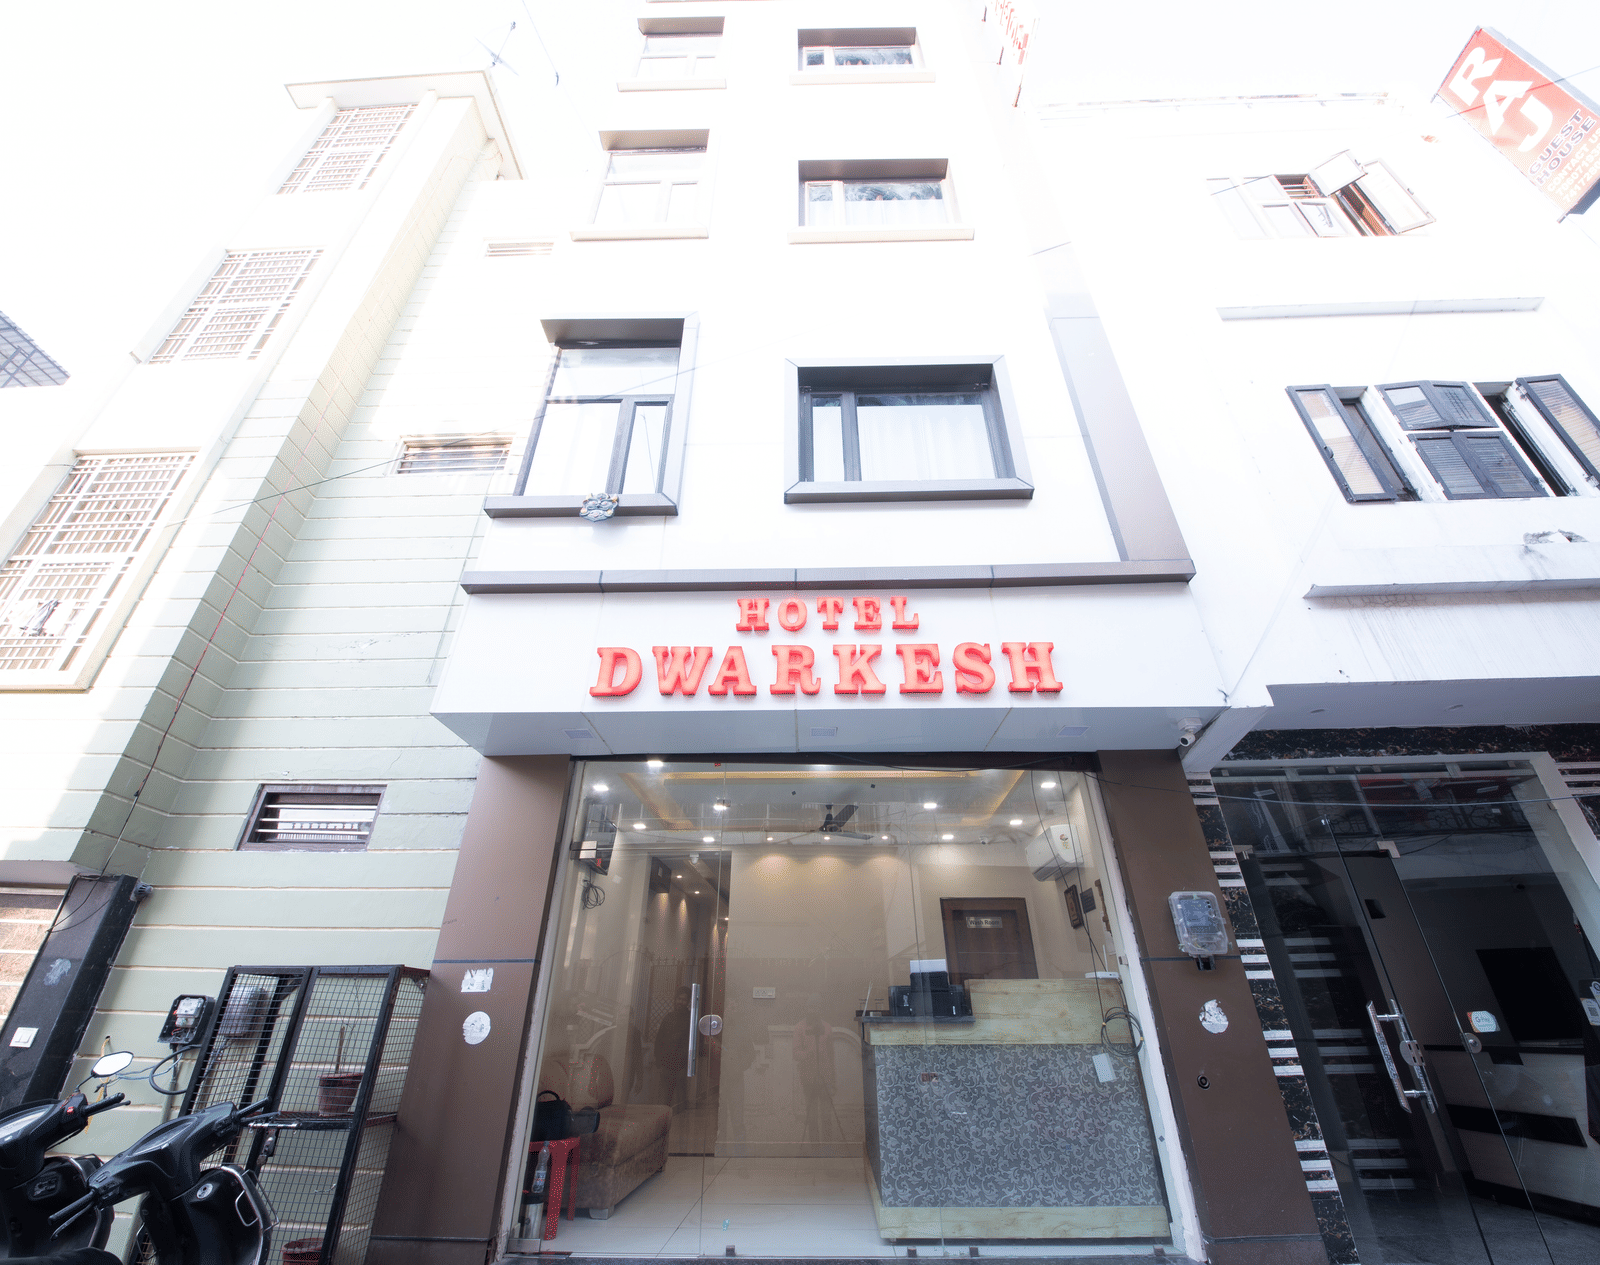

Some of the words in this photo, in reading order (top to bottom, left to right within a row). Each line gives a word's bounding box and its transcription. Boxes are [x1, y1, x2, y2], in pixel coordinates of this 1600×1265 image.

[1449, 46, 1553, 152] RAJ
[1528, 108, 1583, 176] GUEST
[1535, 116, 1597, 187] HOUSE
[1547, 143, 1589, 192] CONTACT
[736, 596, 919, 632] HOTEL
[589, 642, 1063, 697] DWARKESH
